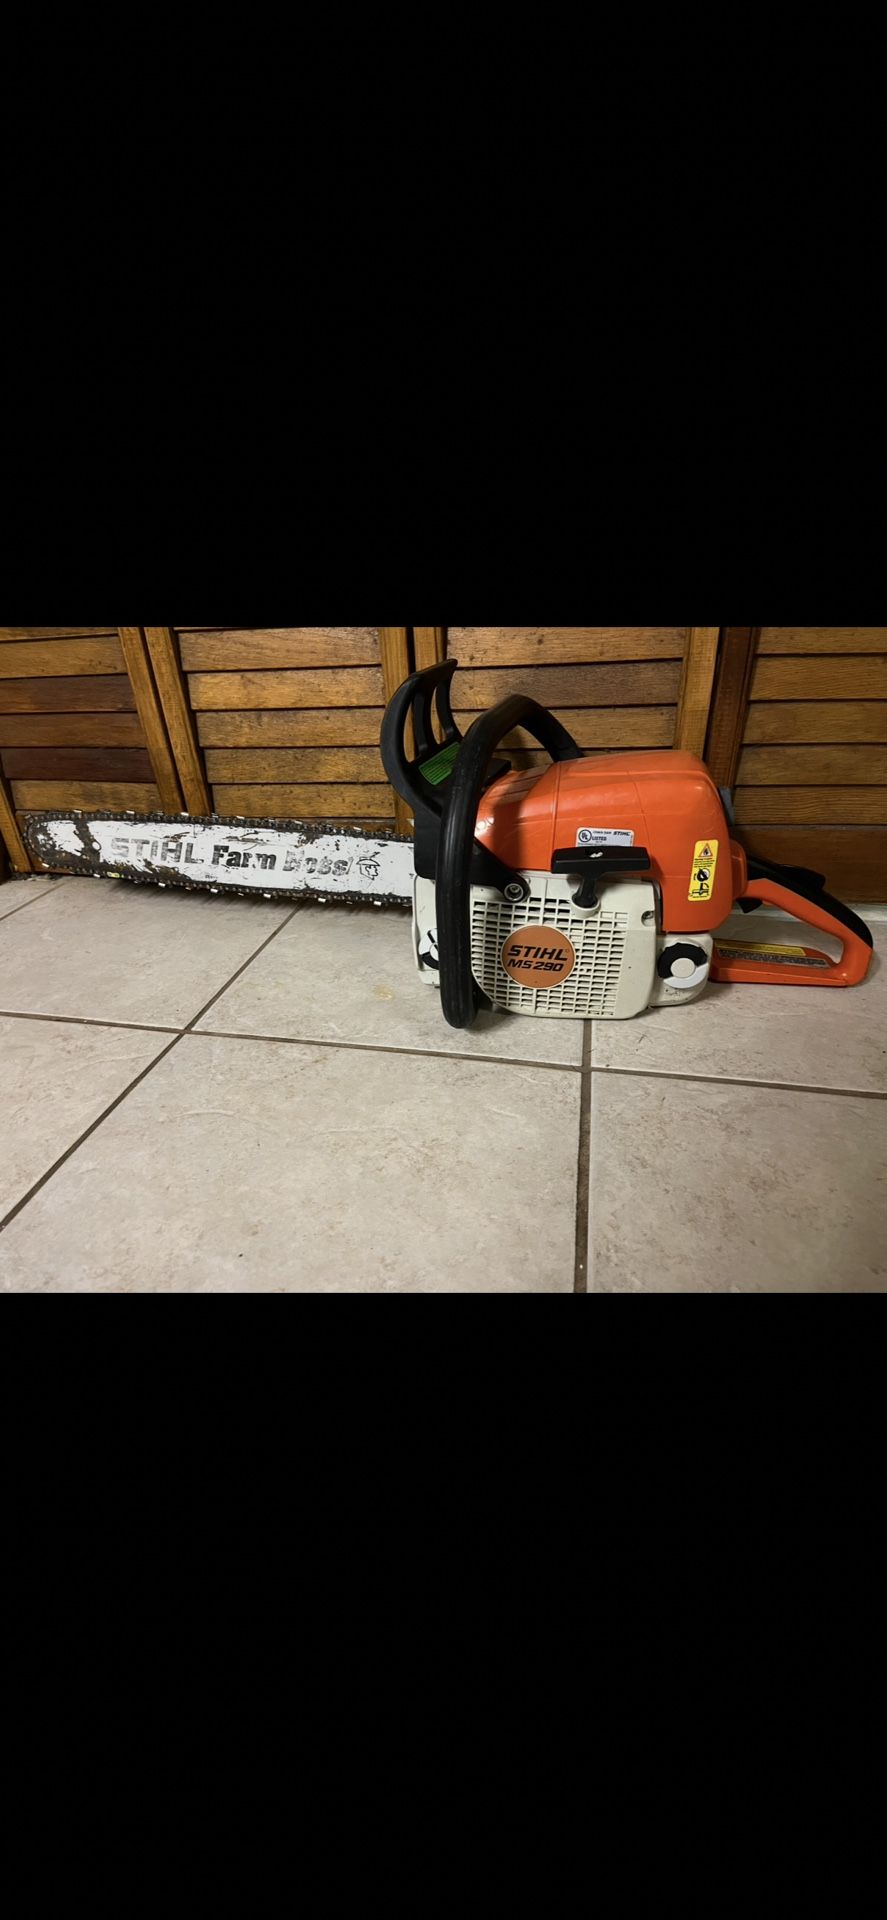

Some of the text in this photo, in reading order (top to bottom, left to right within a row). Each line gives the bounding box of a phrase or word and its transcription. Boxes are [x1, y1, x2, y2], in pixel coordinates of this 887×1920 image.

[110, 836, 204, 865] STIHL
[211, 844, 277, 870] Farm
[507, 944, 568, 961] STIHL
[507, 958, 565, 972] MS 290
